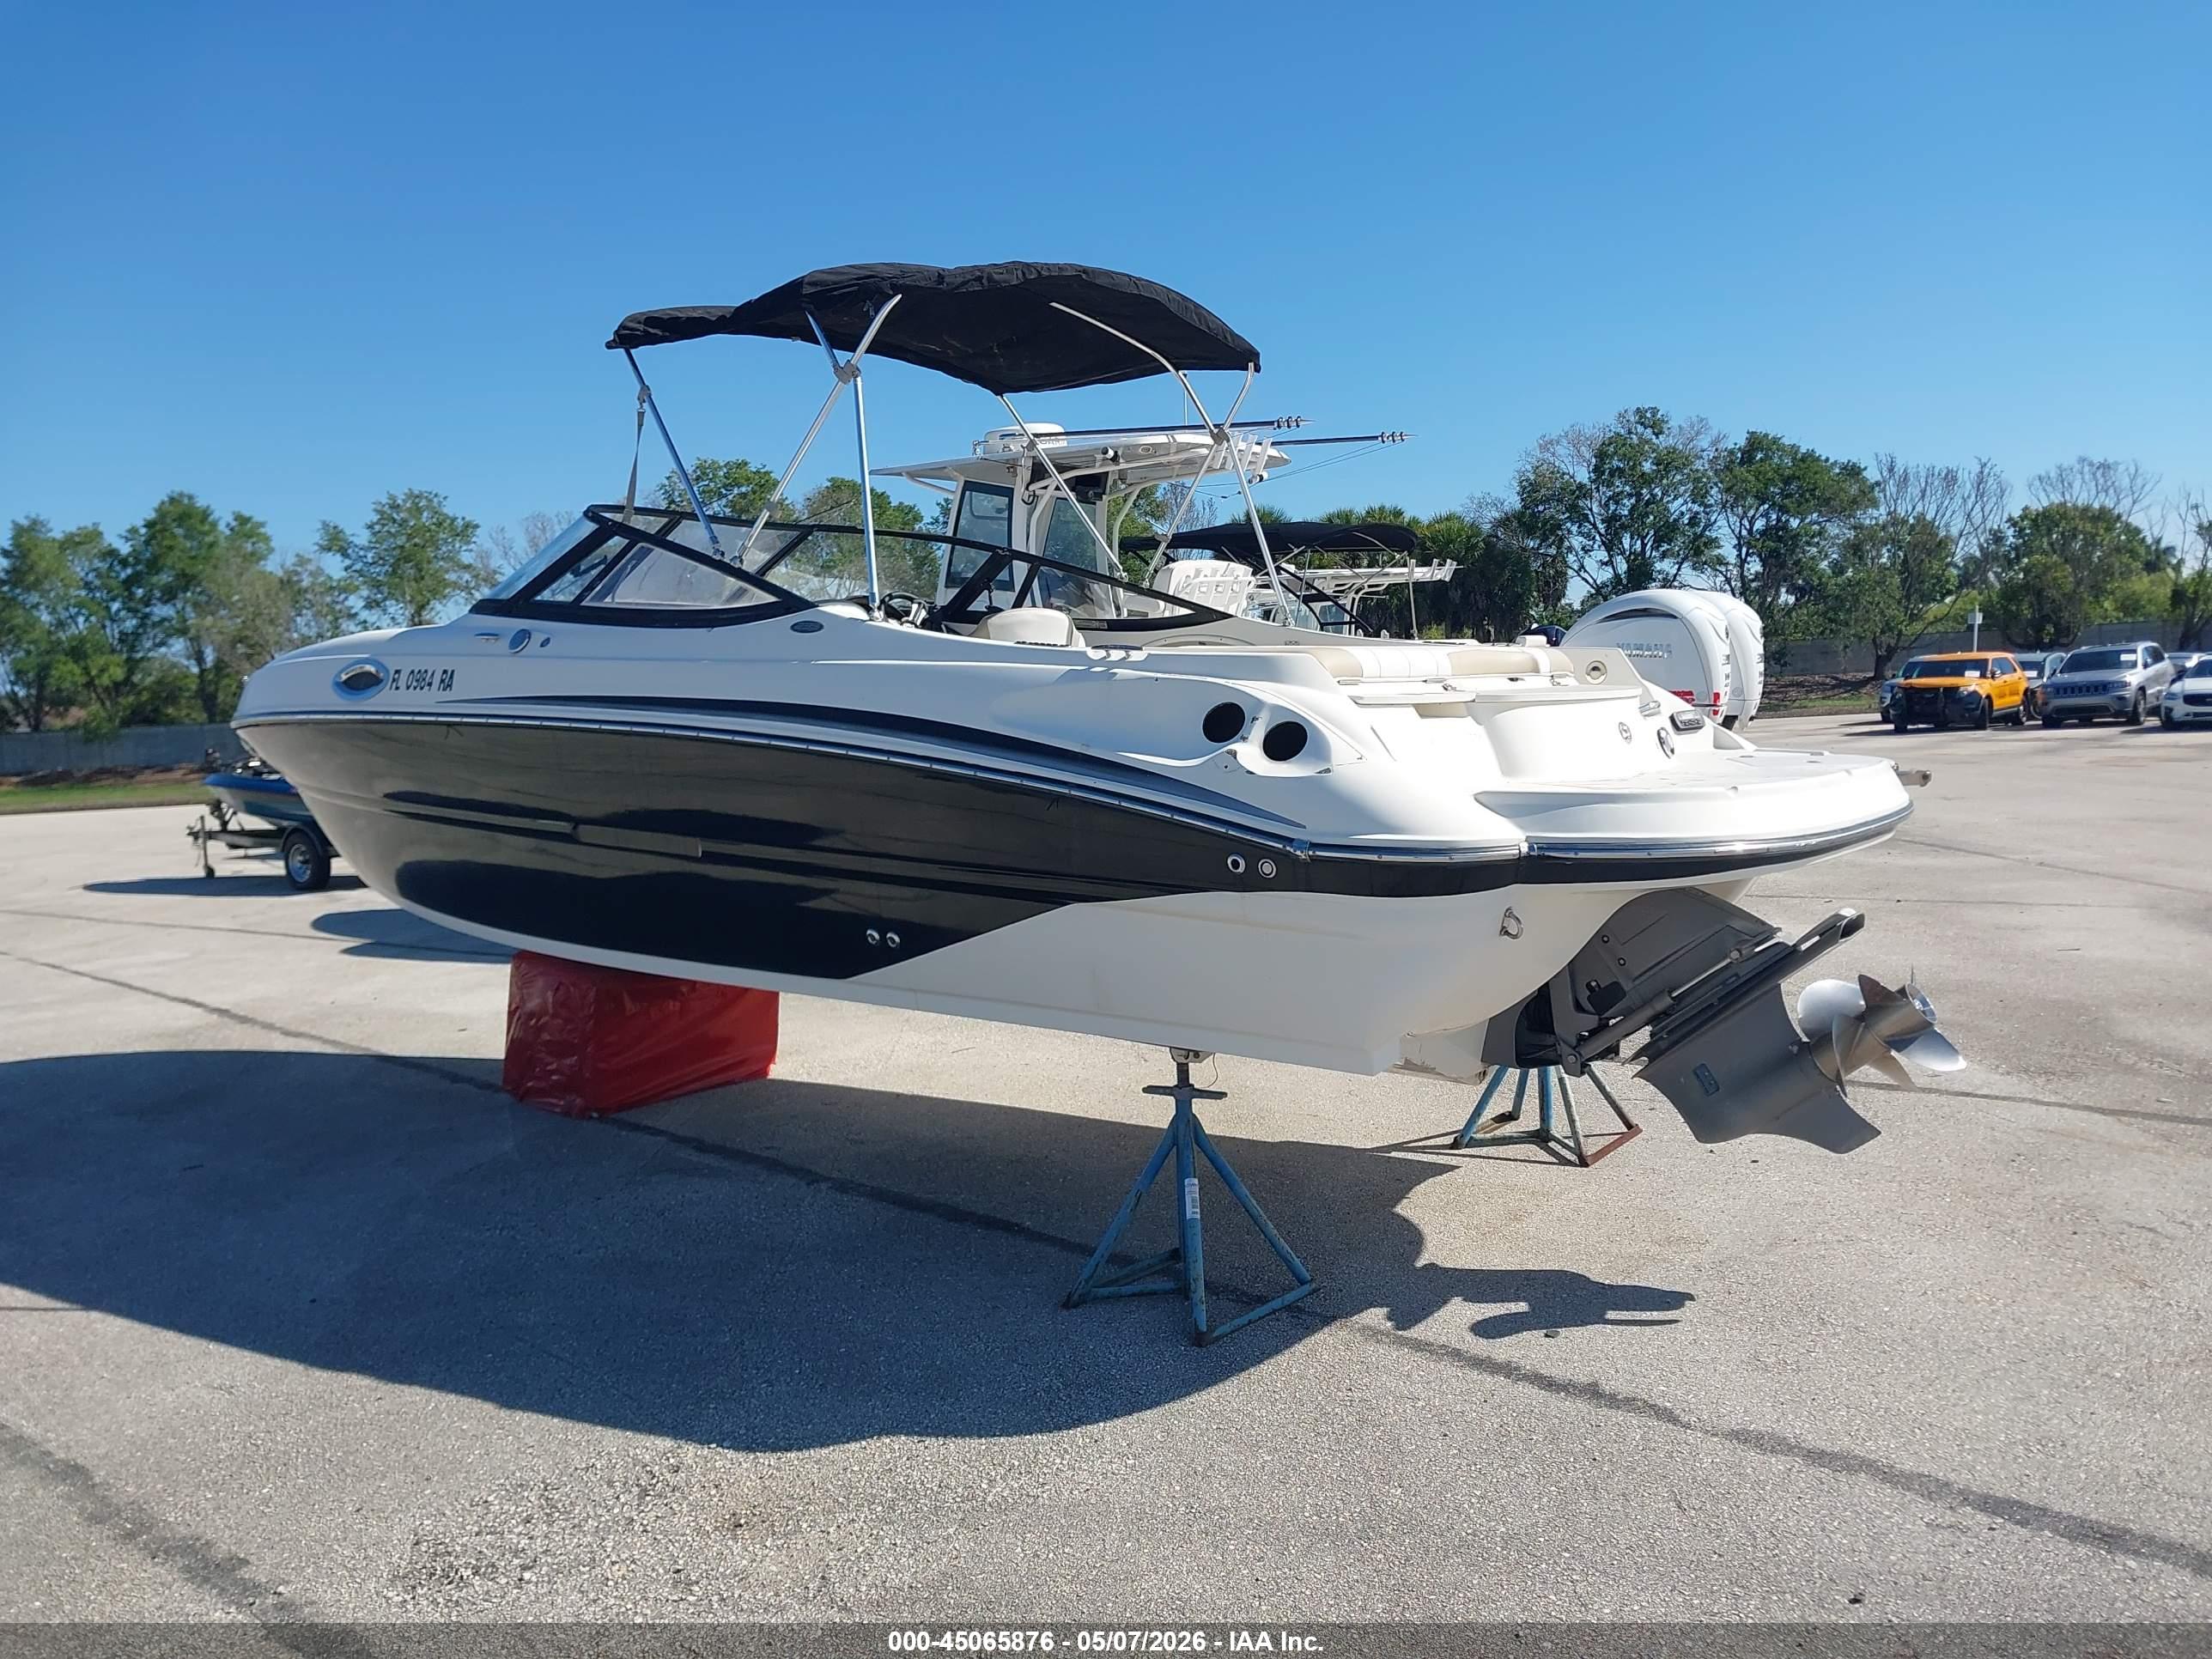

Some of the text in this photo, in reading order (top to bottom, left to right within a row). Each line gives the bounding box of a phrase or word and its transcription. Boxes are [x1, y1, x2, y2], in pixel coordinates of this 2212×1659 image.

[389, 669, 455, 691] FL 0984 RA
